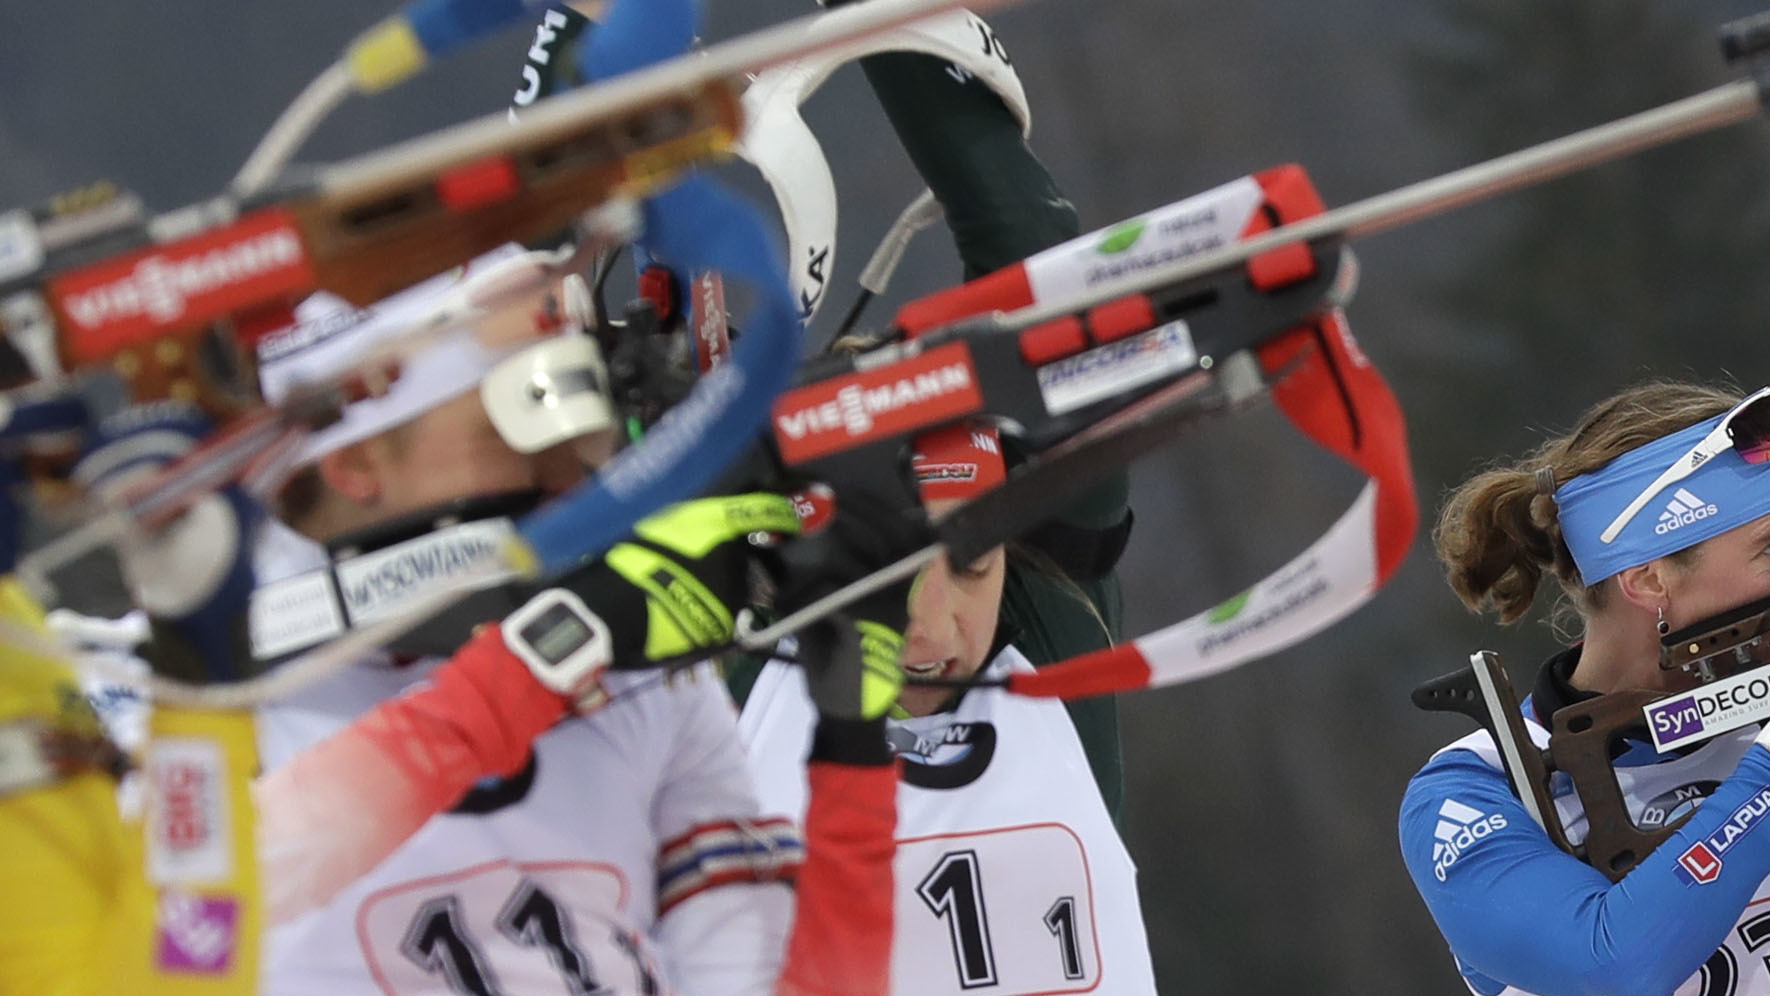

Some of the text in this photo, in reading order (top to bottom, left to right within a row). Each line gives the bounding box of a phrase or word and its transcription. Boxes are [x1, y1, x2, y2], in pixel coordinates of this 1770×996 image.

[778, 364, 970, 438] VIESSMANN
[1654, 501, 1719, 536] adidas
[1433, 812, 1508, 882] adidas
[915, 849, 1085, 990] 1 1
